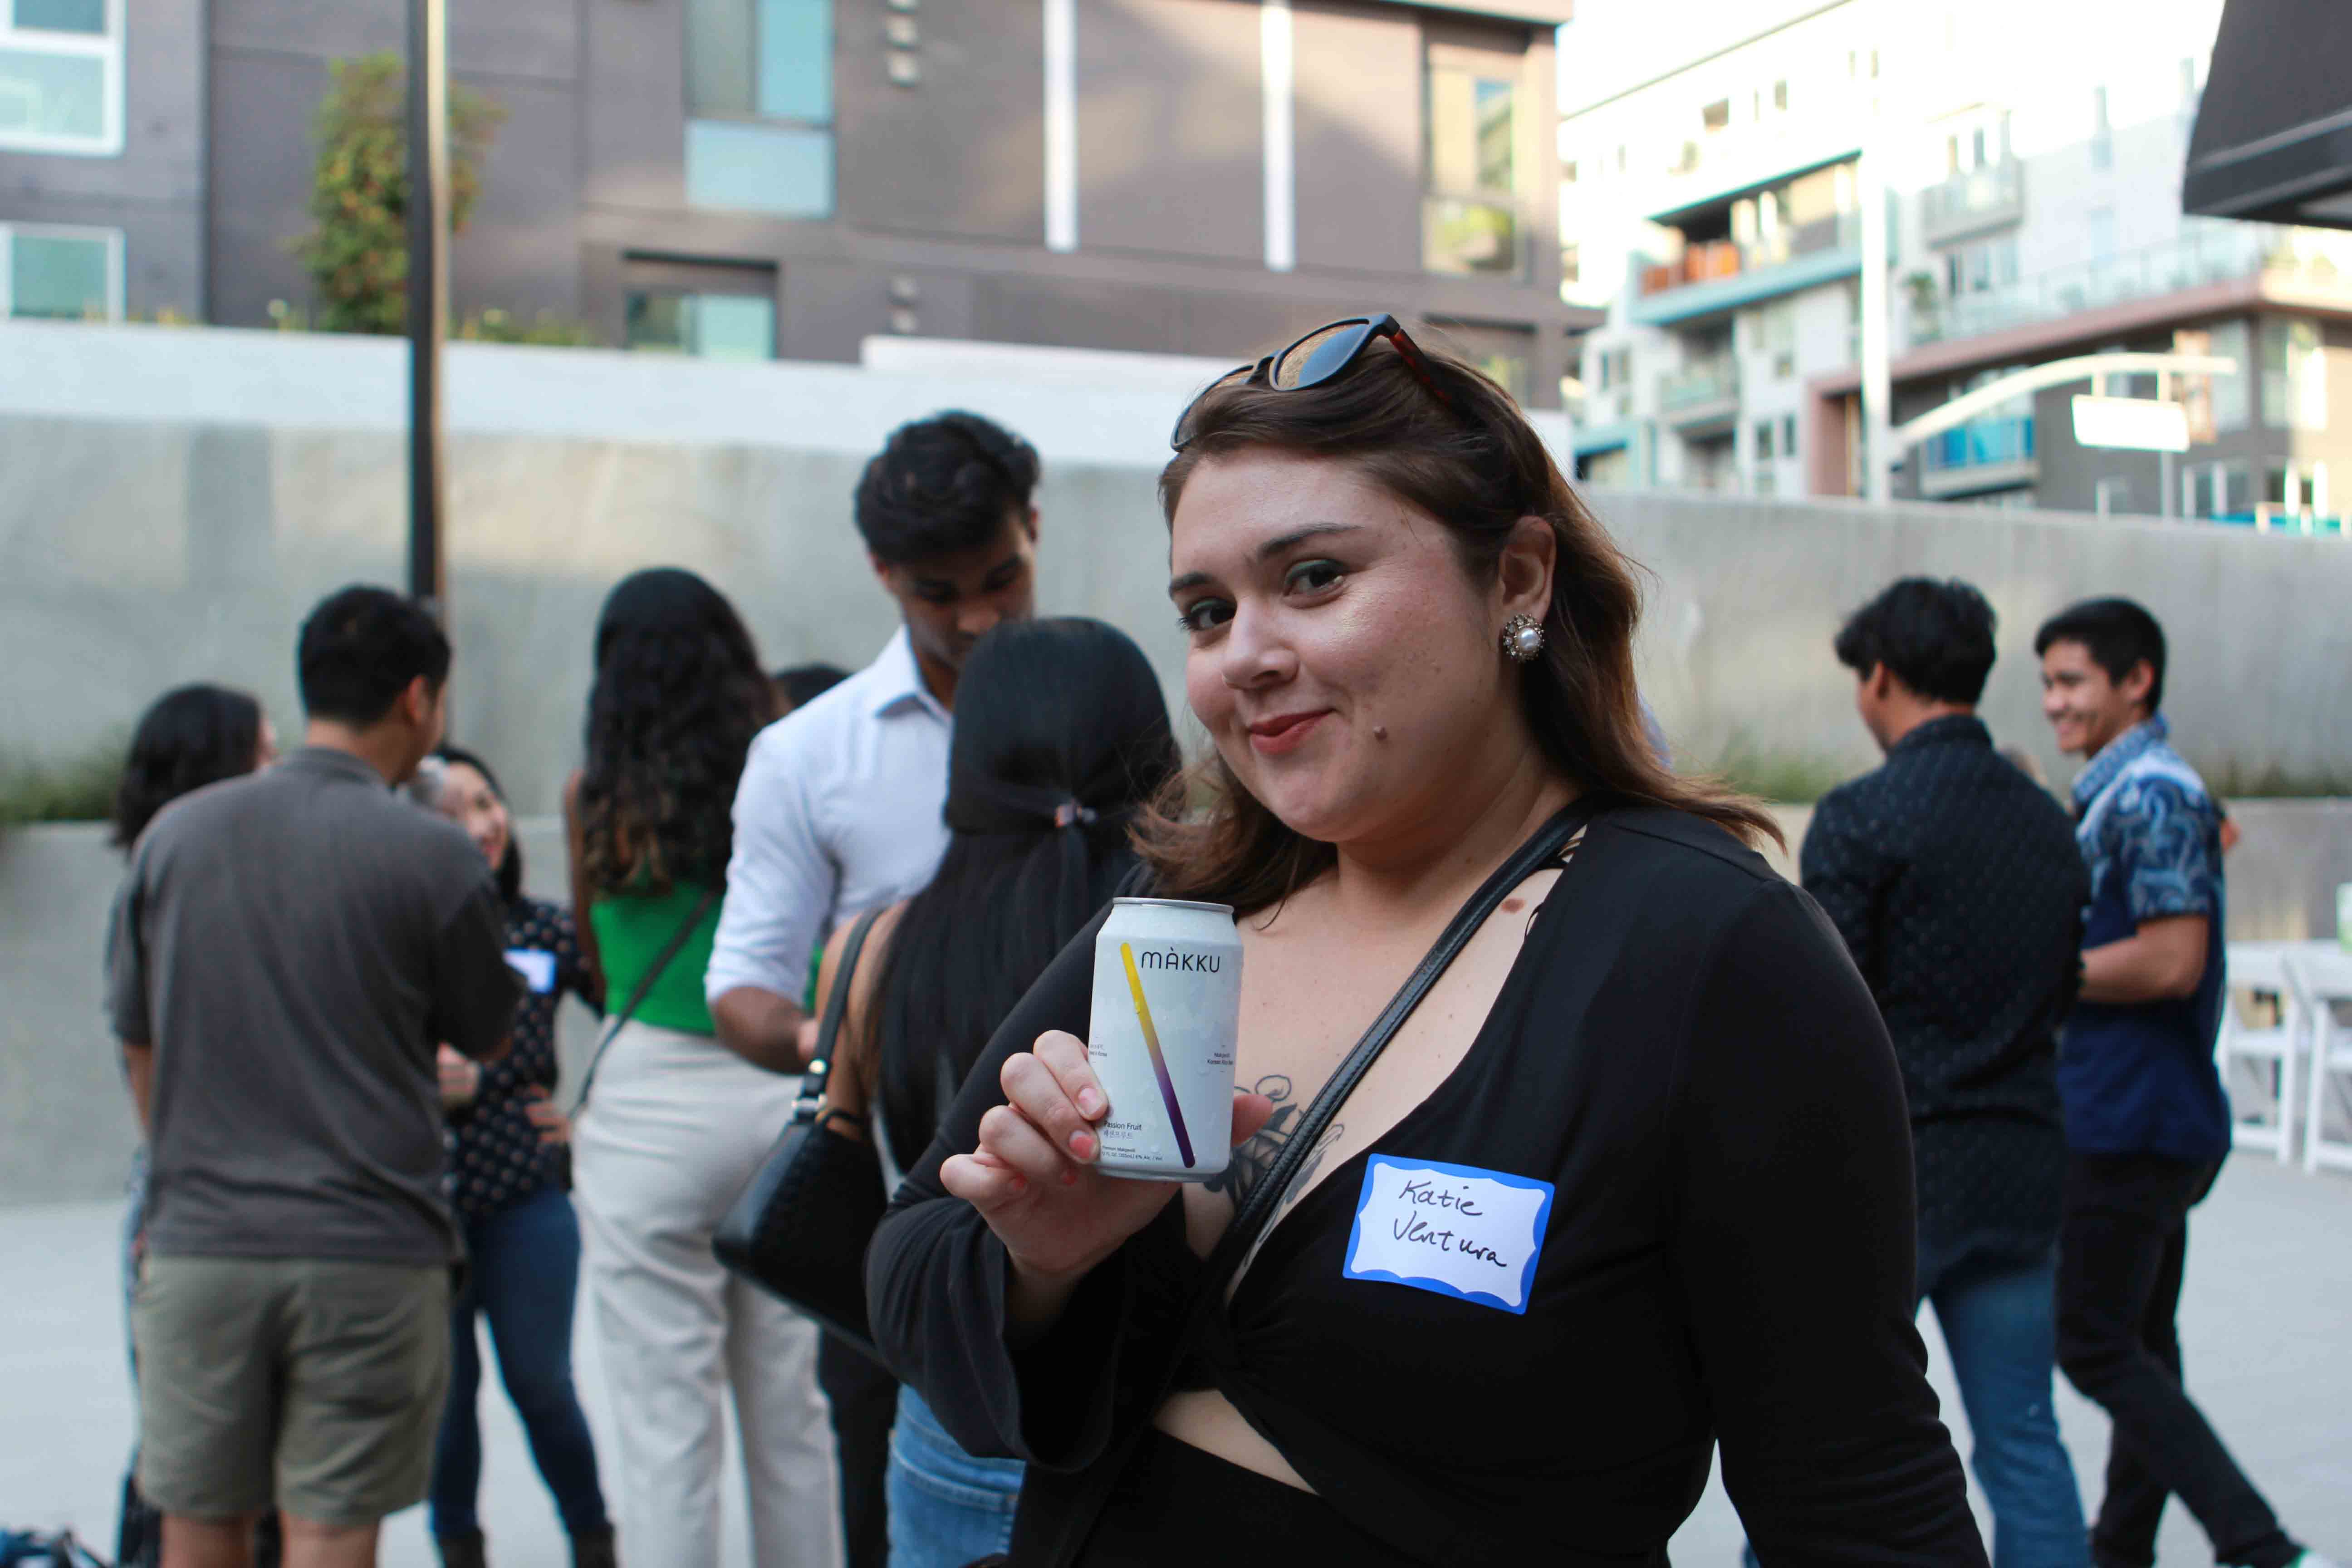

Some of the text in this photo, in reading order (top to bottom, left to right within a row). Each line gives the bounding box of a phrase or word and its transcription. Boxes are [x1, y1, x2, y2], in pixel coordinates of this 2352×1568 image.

[1103, 1120, 1125, 1129] Passion
[1398, 1179, 1483, 1216] Katie
[1393, 1210, 1508, 1268] Ventura
